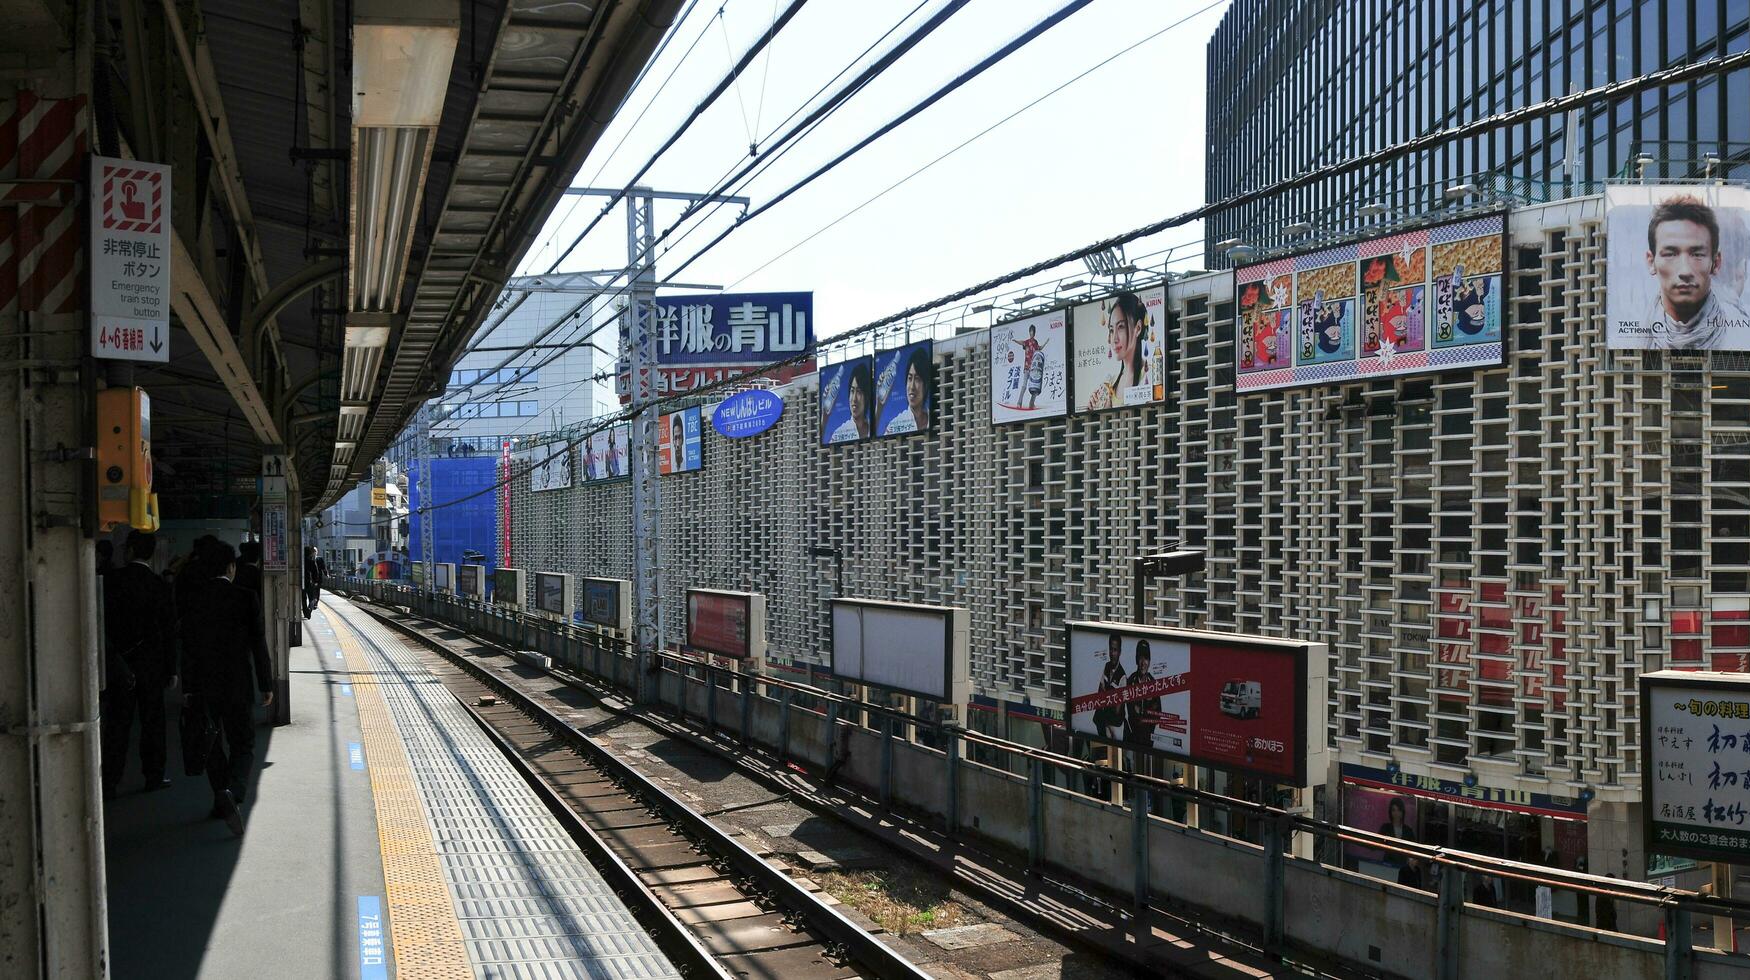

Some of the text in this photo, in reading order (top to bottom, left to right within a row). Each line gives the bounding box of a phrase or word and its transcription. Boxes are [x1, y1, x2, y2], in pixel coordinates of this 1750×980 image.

[104, 238, 160, 259] 非常停止
[123, 261, 160, 278] ボタン
[111, 280, 160, 294] Emergency
[120, 294, 160, 306] train stop
[1146, 298, 1162, 308] KIRIN
[133, 307, 160, 317] button
[1706, 319, 1750, 328] HUMAN
[1657, 736, 1694, 750] やえす
[1659, 803, 1697, 821] 居酒屋
